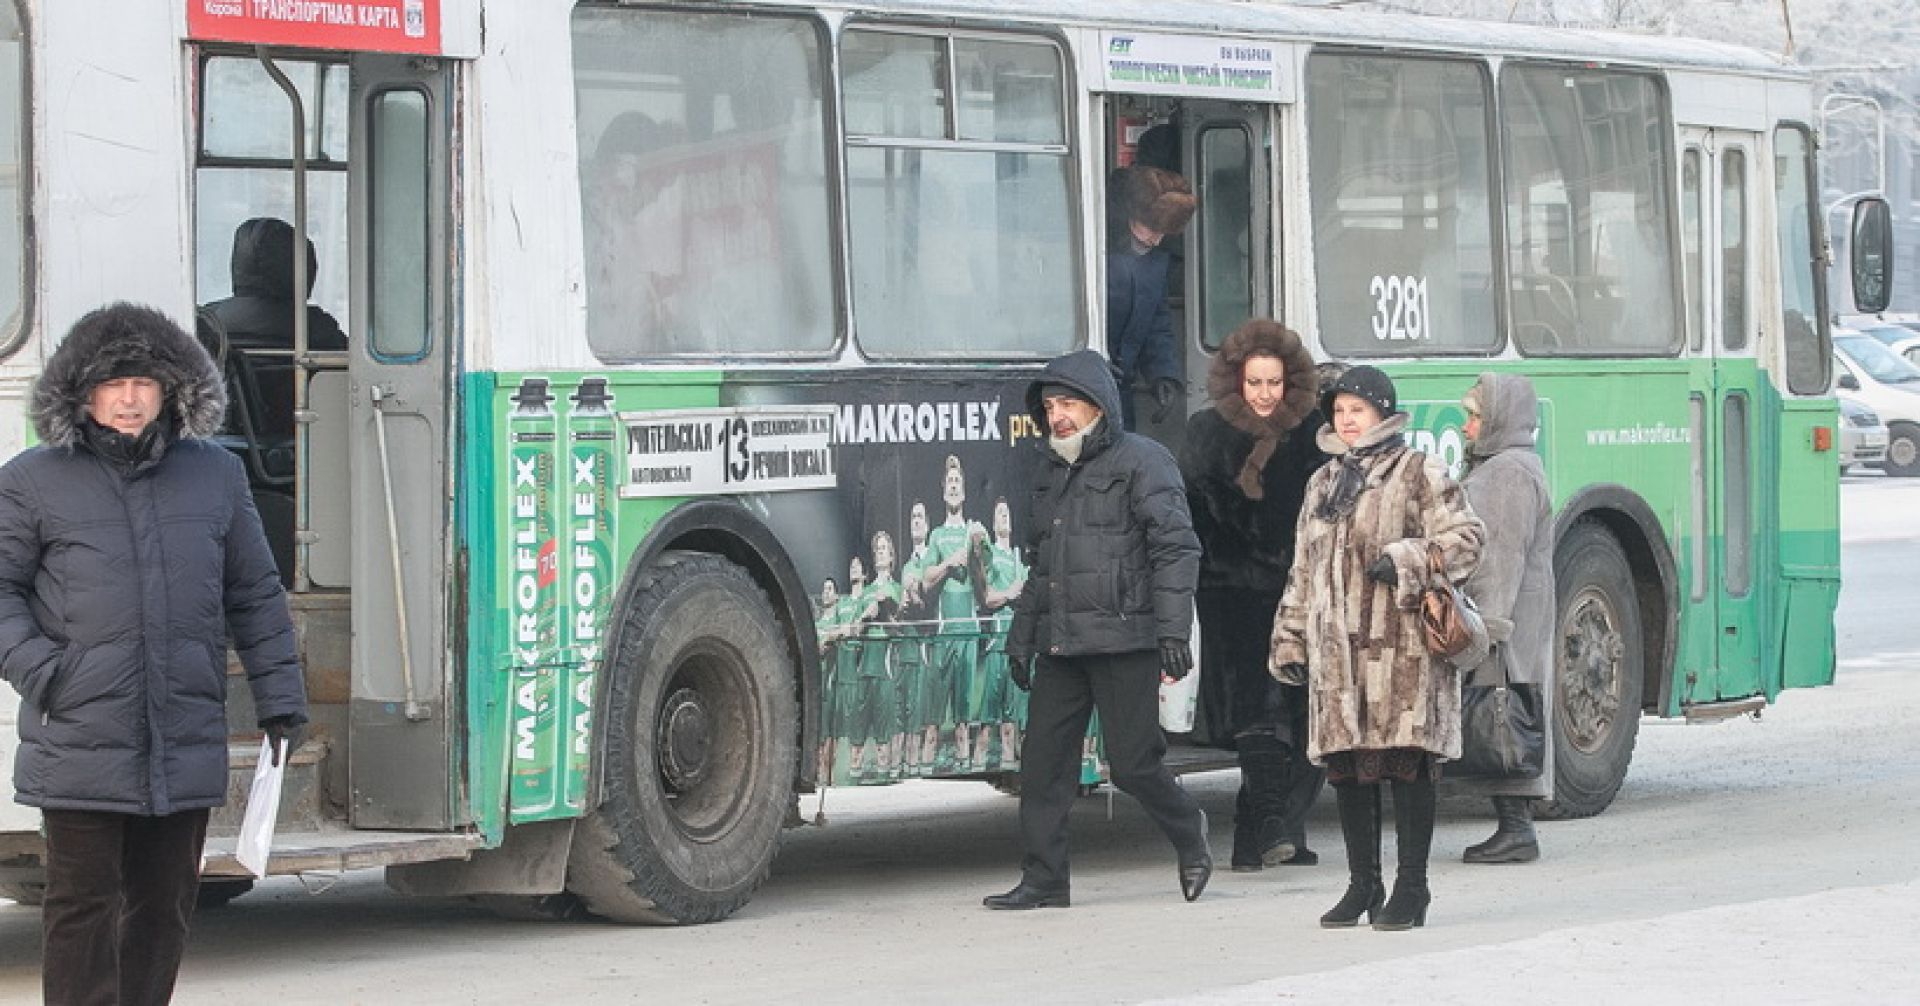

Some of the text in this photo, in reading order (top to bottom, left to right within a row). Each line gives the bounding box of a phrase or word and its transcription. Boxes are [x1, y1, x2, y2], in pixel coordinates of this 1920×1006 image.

[254, 0, 400, 28] ТРАНСПОРТНАЯ КАРТА
[1182, 63, 1220, 87] ЧИСТЫЙ
[1222, 67, 1272, 90] ТРАНСПОРТ
[1370, 275, 1431, 340] 3281
[627, 423, 713, 454] УЧИТЕЛЬСКАЯ
[834, 402, 1002, 443] MAKROFLEX
[718, 416, 749, 483] 13
[753, 444, 828, 480] РЕЧНОЙ ВОКЗАЛ
[632, 466, 691, 483] АВТОВОКЗАЛ
[516, 453, 537, 760] MAKROFLEX
[575, 453, 597, 755] MAKROFLEX
